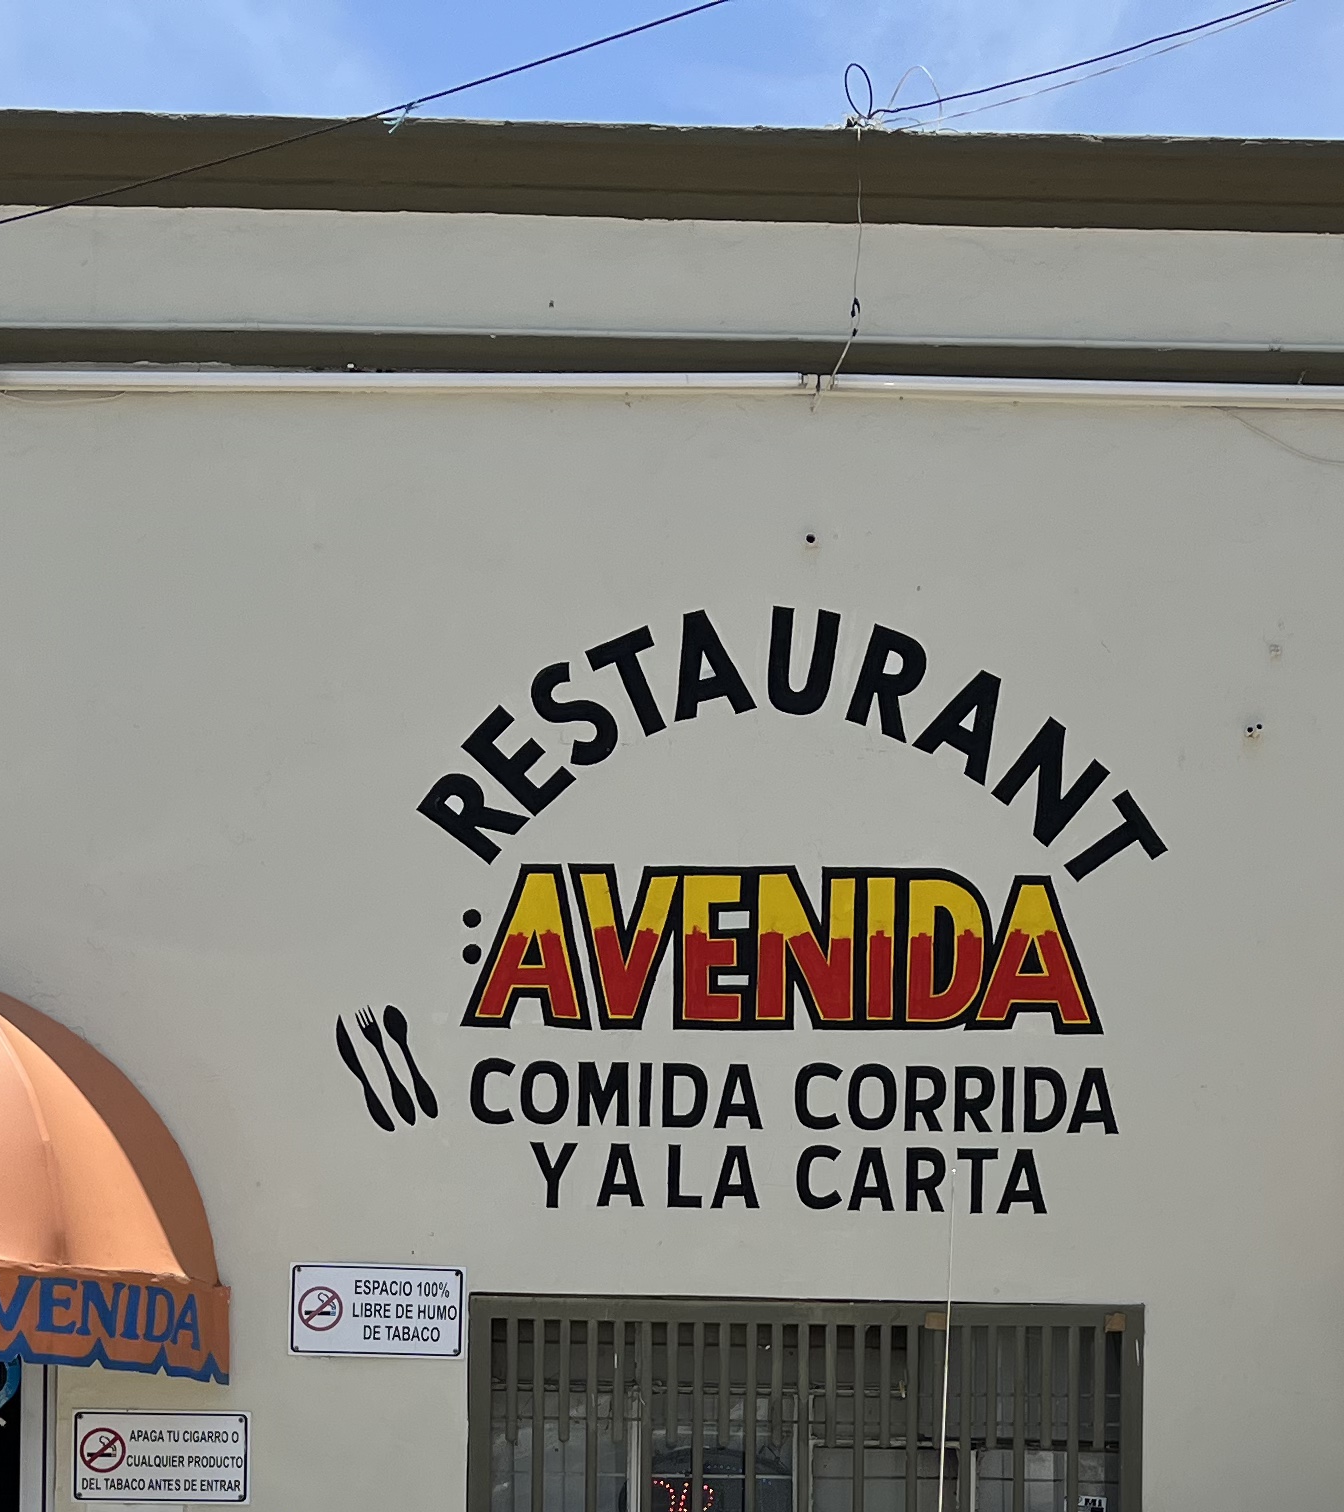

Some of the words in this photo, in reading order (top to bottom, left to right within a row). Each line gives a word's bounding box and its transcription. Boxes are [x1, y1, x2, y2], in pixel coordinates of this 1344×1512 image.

[416, 605, 1169, 882] RESTAURANT
[461, 862, 1104, 1034] AVENIDA
[468, 1058, 763, 1130] COMIDA
[794, 1064, 1119, 1134] CORRIDA
[531, 1141, 578, 1209] Y
[597, 1143, 644, 1208] A
[667, 1144, 760, 1210] LA
[795, 1144, 1048, 1214] CARTA
[354, 1280, 412, 1297] ESPACIO
[416, 1282, 450, 1298] 100%
[352, 1303, 391, 1319] LIBRE
[396, 1304, 413, 1320] DE
[417, 1305, 457, 1321] HUMO
[363, 1325, 381, 1341] DE
[385, 1326, 441, 1342] TABACO
[129, 1430, 165, 1443] APAGA
[167, 1430, 180, 1443] TU
[182, 1430, 228, 1443] CIGARRO
[232, 1431, 239, 1443] O
[126, 1455, 185, 1469] CUALQUIER
[187, 1456, 243, 1469] PRODUCTO
[82, 1478, 101, 1490] DEL
[104, 1478, 145, 1491] TABACO
[147, 1479, 180, 1491] ANTES
[183, 1479, 197, 1491] DE
[199, 1479, 241, 1492] ENTRAR
